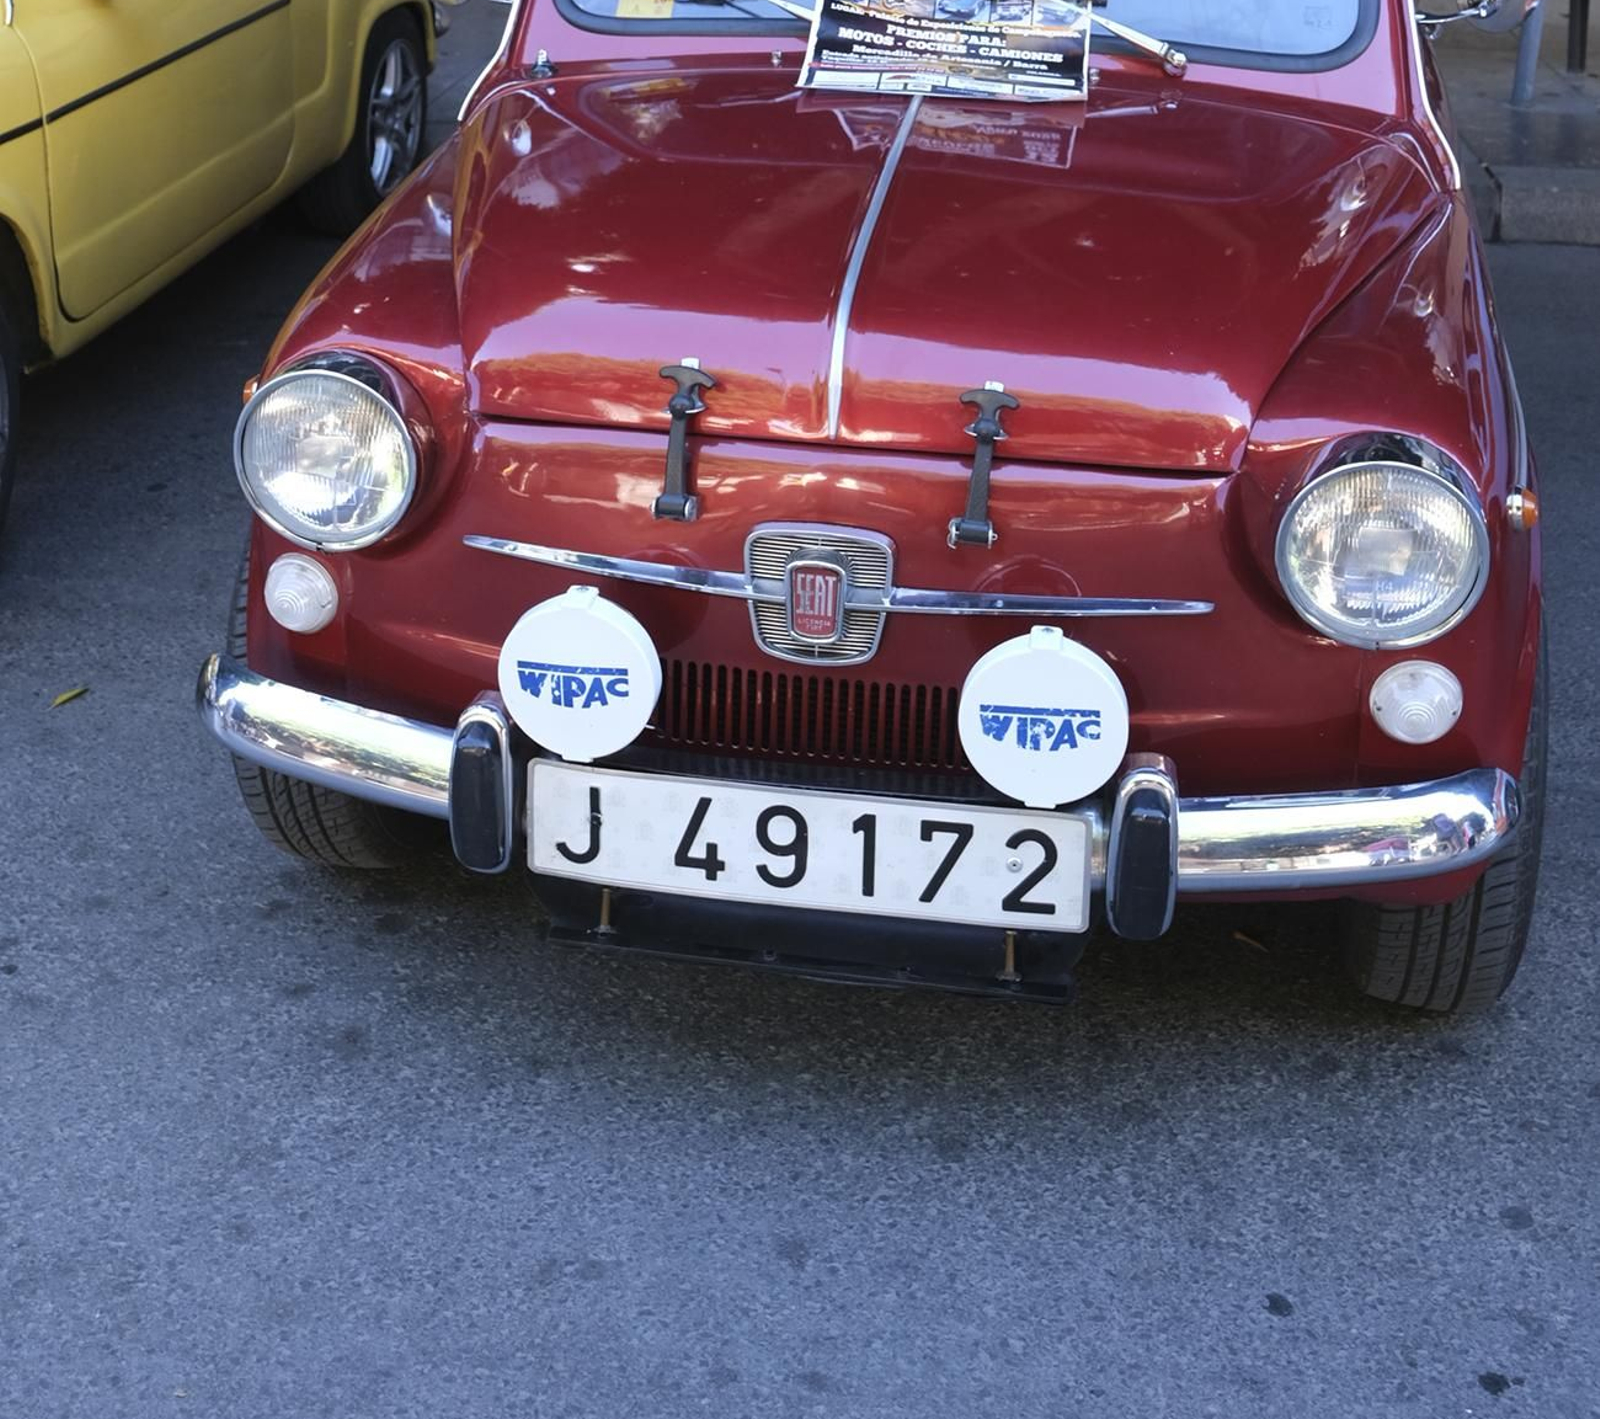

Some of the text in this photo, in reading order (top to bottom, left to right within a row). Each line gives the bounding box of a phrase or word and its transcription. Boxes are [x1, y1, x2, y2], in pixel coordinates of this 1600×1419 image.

[838, 26, 895, 46] MOTOS
[905, 39, 967, 54] COCHES
[978, 47, 1064, 63] CAMIONES
[886, 24, 1006, 47] PREMIOS PARA:
[796, 573, 837, 617] SEAT
[517, 670, 629, 708] WIPAC
[979, 714, 1101, 752] WIPAC
[556, 785, 1058, 916] J 49172
